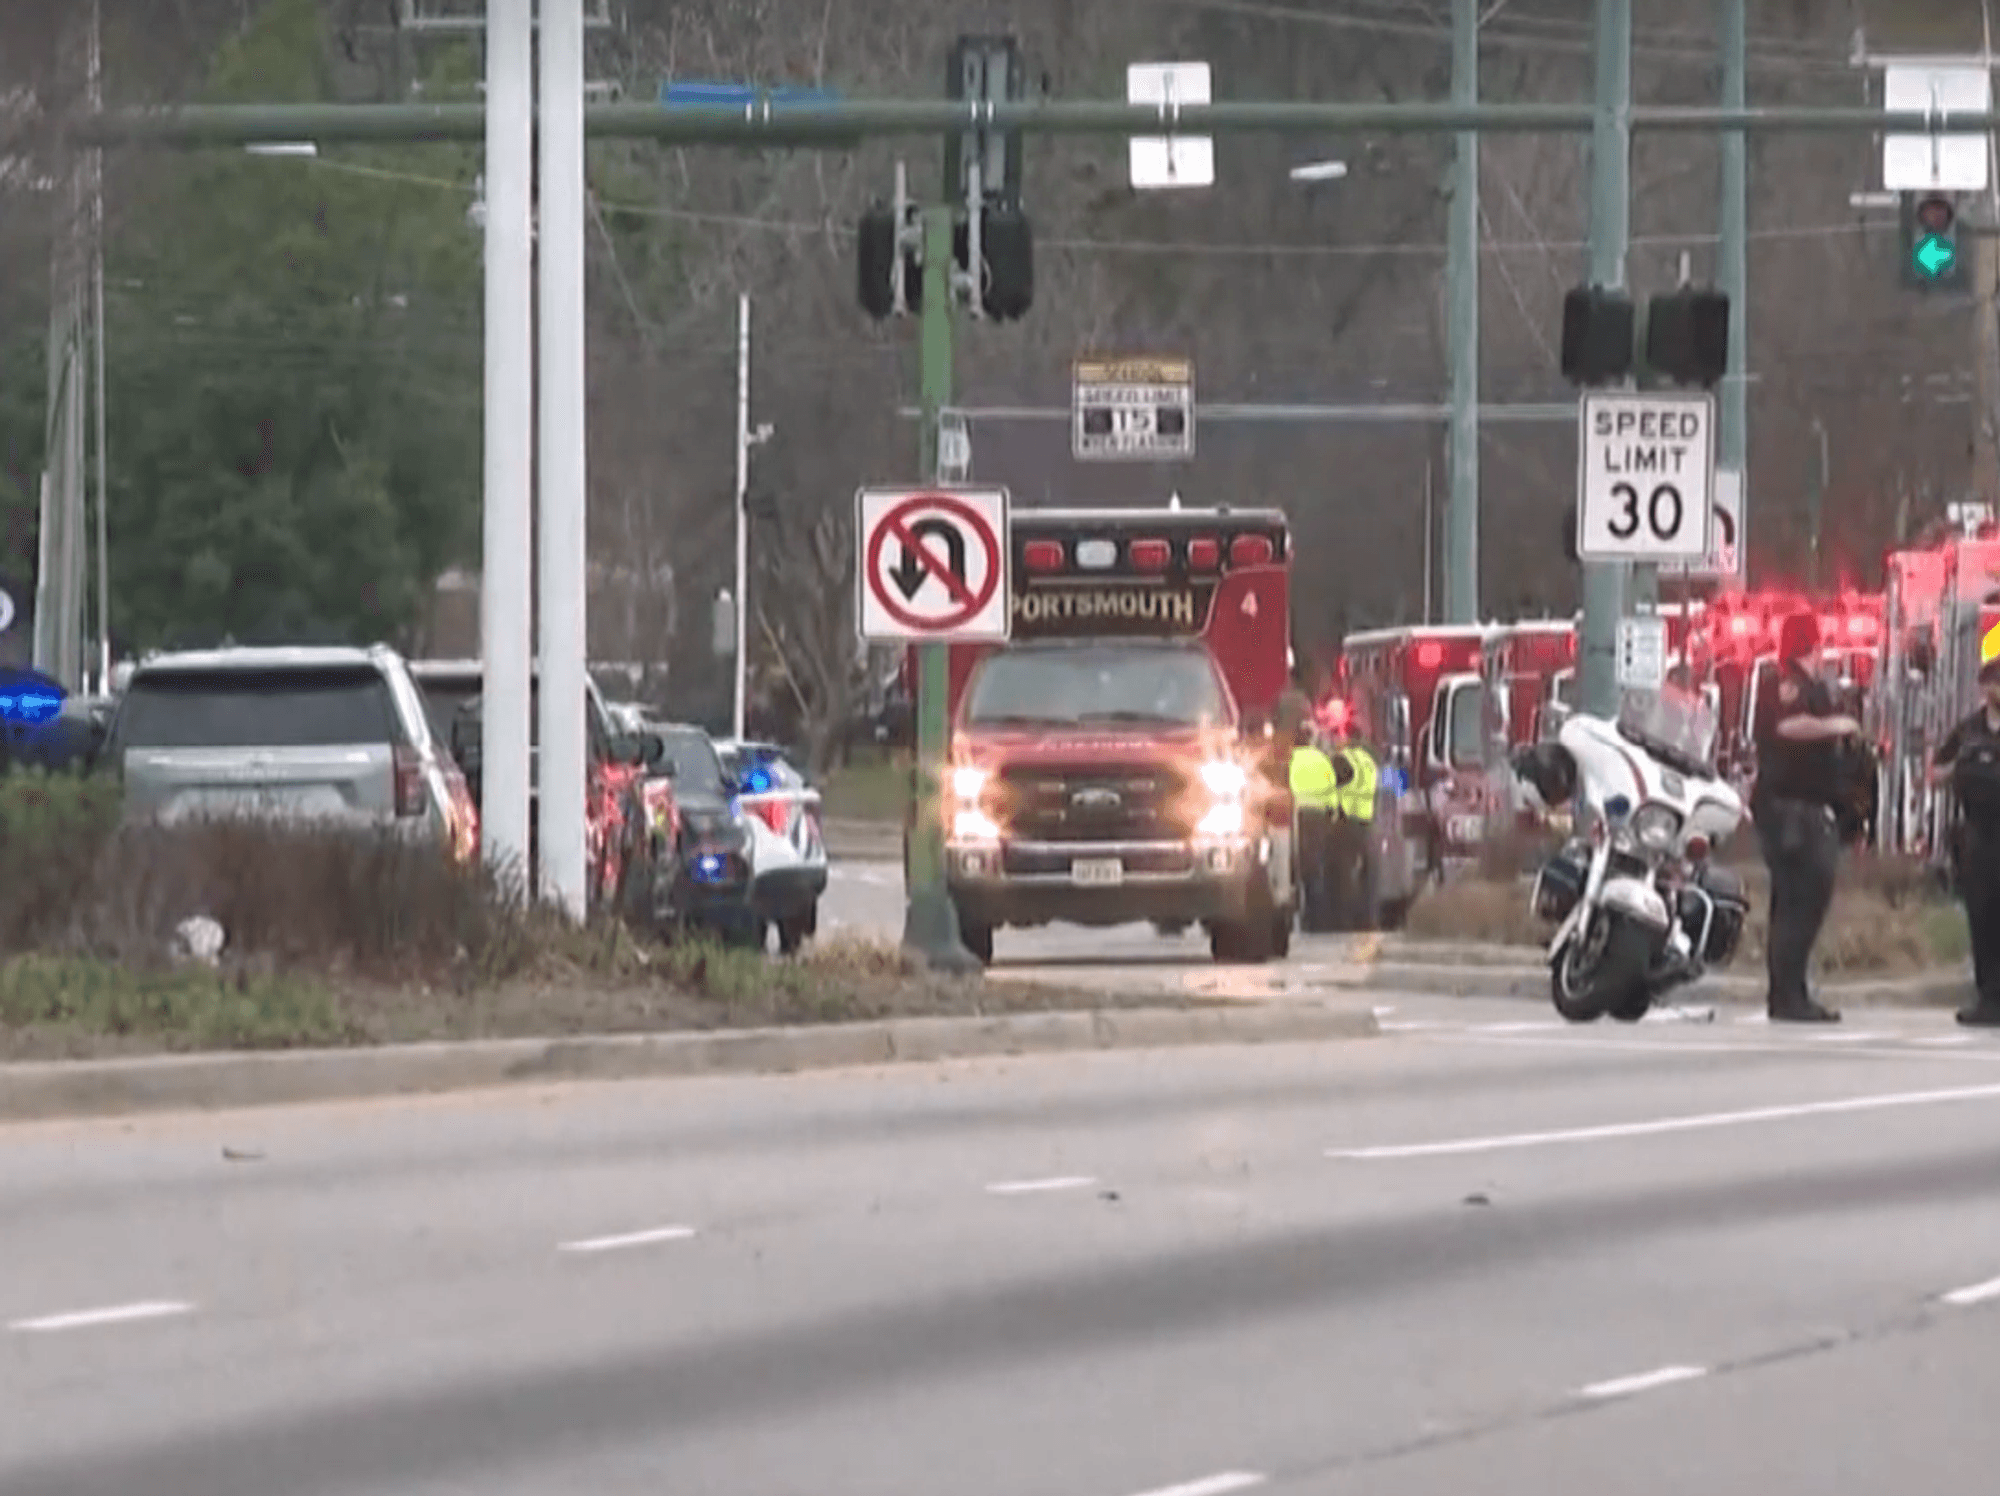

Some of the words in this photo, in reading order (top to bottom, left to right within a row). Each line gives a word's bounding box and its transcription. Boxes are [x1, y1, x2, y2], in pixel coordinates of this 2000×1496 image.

[1120, 407, 1151, 432] 15
[1595, 411, 1699, 438] SPEED
[1604, 445, 1687, 473] LIMIT
[1608, 481, 1683, 541] 30
[1240, 589, 1259, 617] 4
